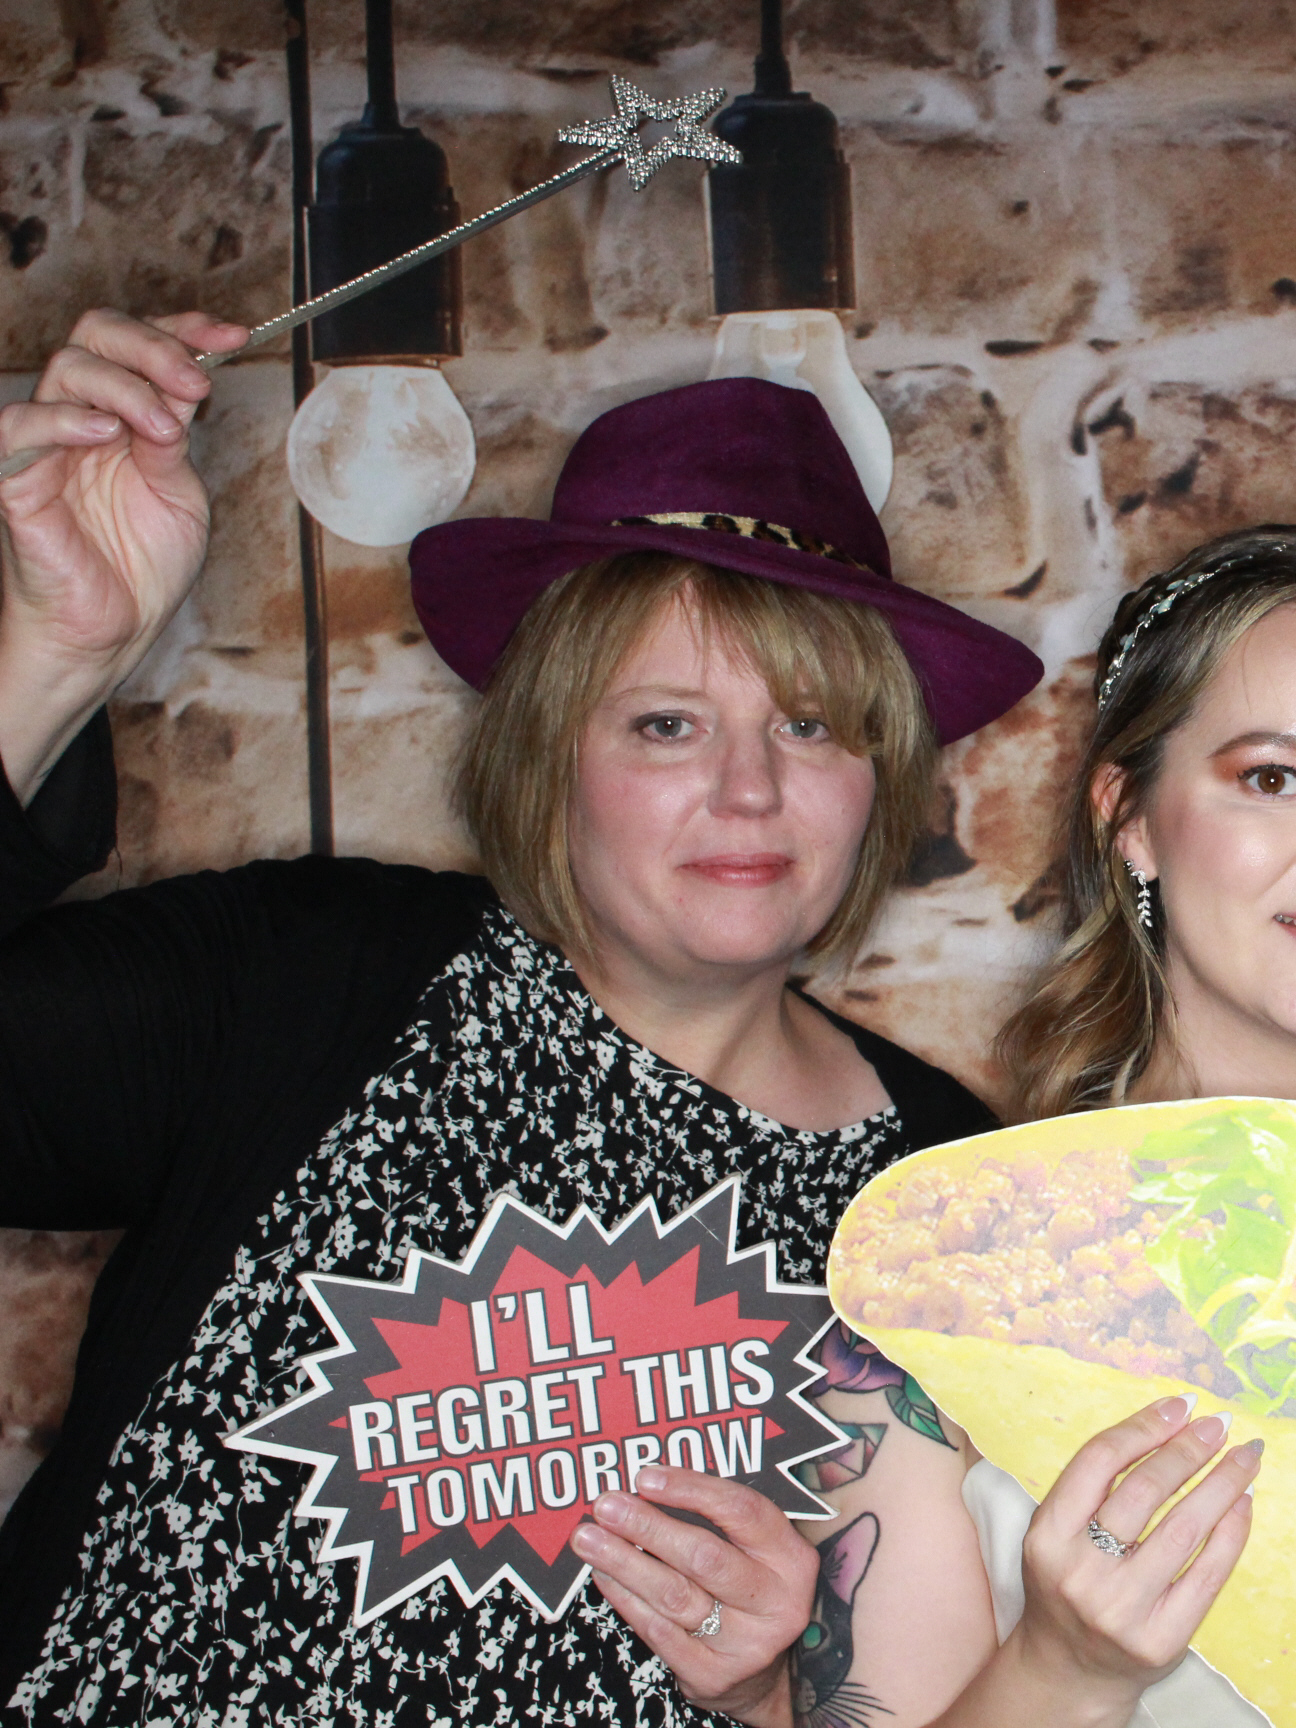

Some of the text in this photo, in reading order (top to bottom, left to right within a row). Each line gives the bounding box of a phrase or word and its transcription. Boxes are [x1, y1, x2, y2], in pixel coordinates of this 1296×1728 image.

[471, 1285, 613, 1372] I'LL
[349, 1339, 775, 1471] REGRET THIS
[387, 1416, 764, 1534] TOMORROW
